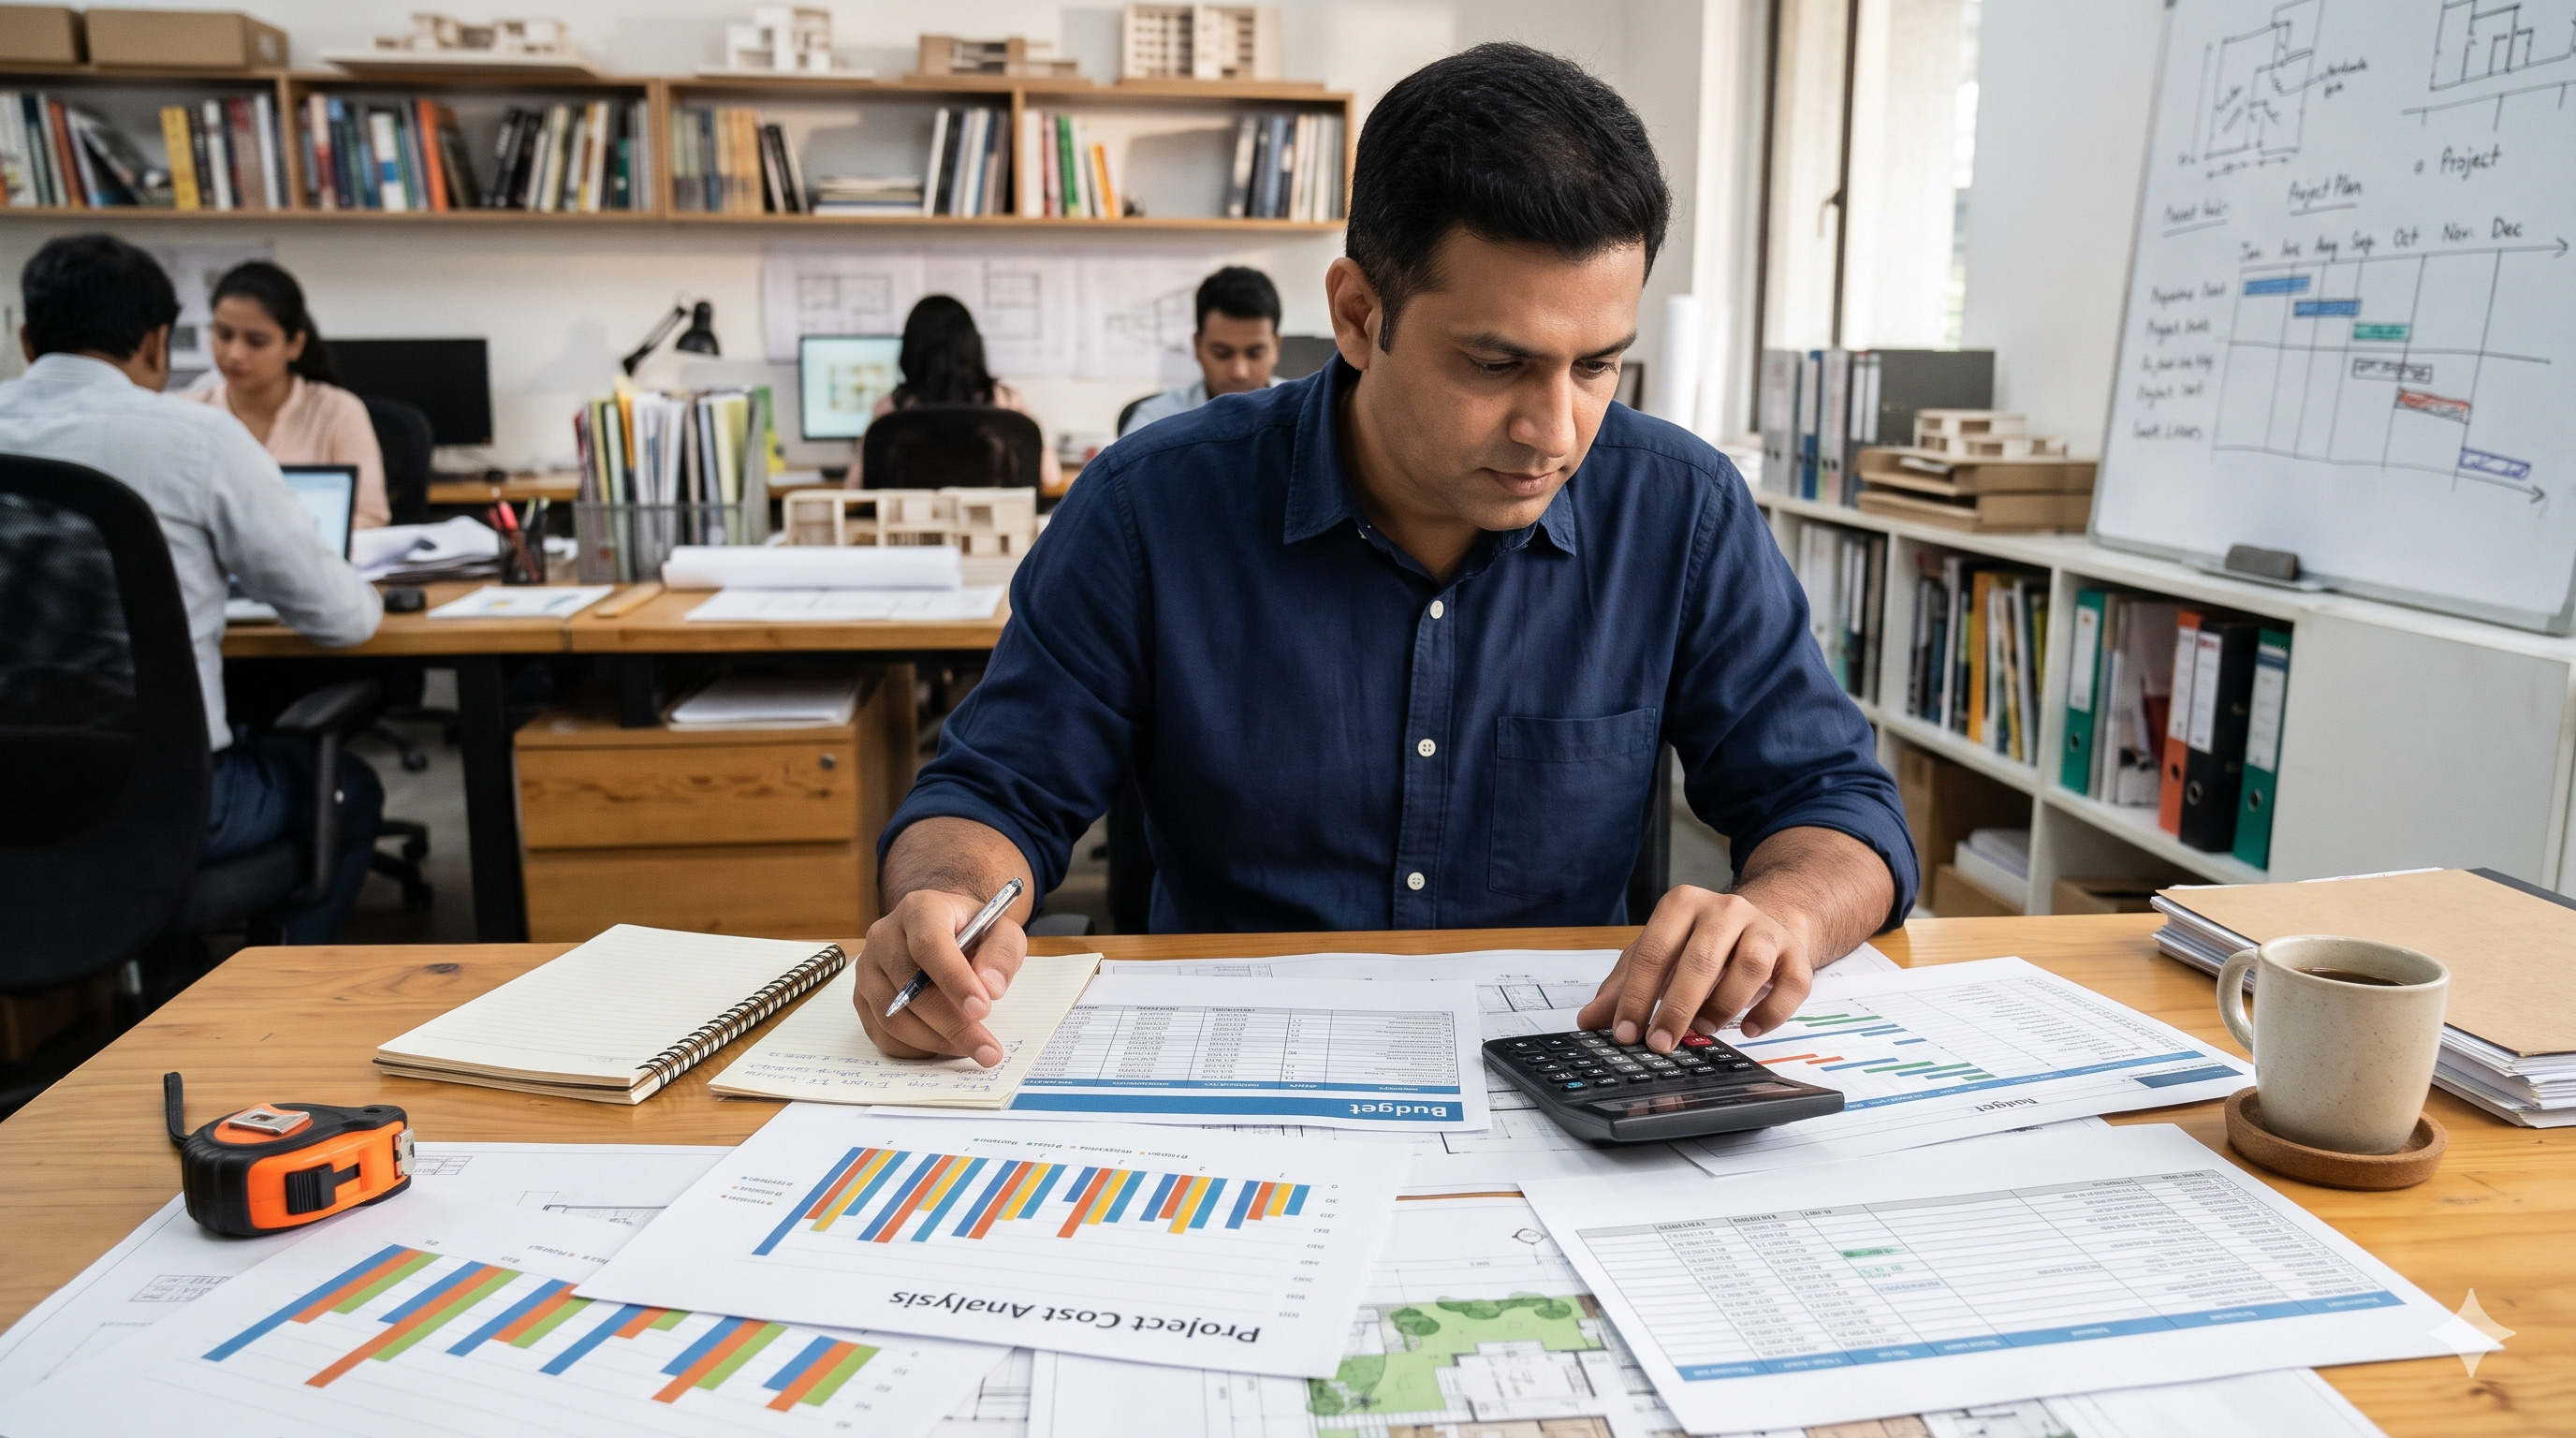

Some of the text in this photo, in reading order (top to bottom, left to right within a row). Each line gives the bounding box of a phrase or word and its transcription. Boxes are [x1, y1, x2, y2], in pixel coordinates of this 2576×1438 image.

[2440, 143, 2502, 181] Project
[2334, 173, 2363, 196] Plan
[2393, 227, 2419, 248] Oct
[2491, 215, 2523, 239] Dec
[1349, 1102, 1447, 1117] Budget
[888, 1291, 1262, 1343] Project Cost Analysis
